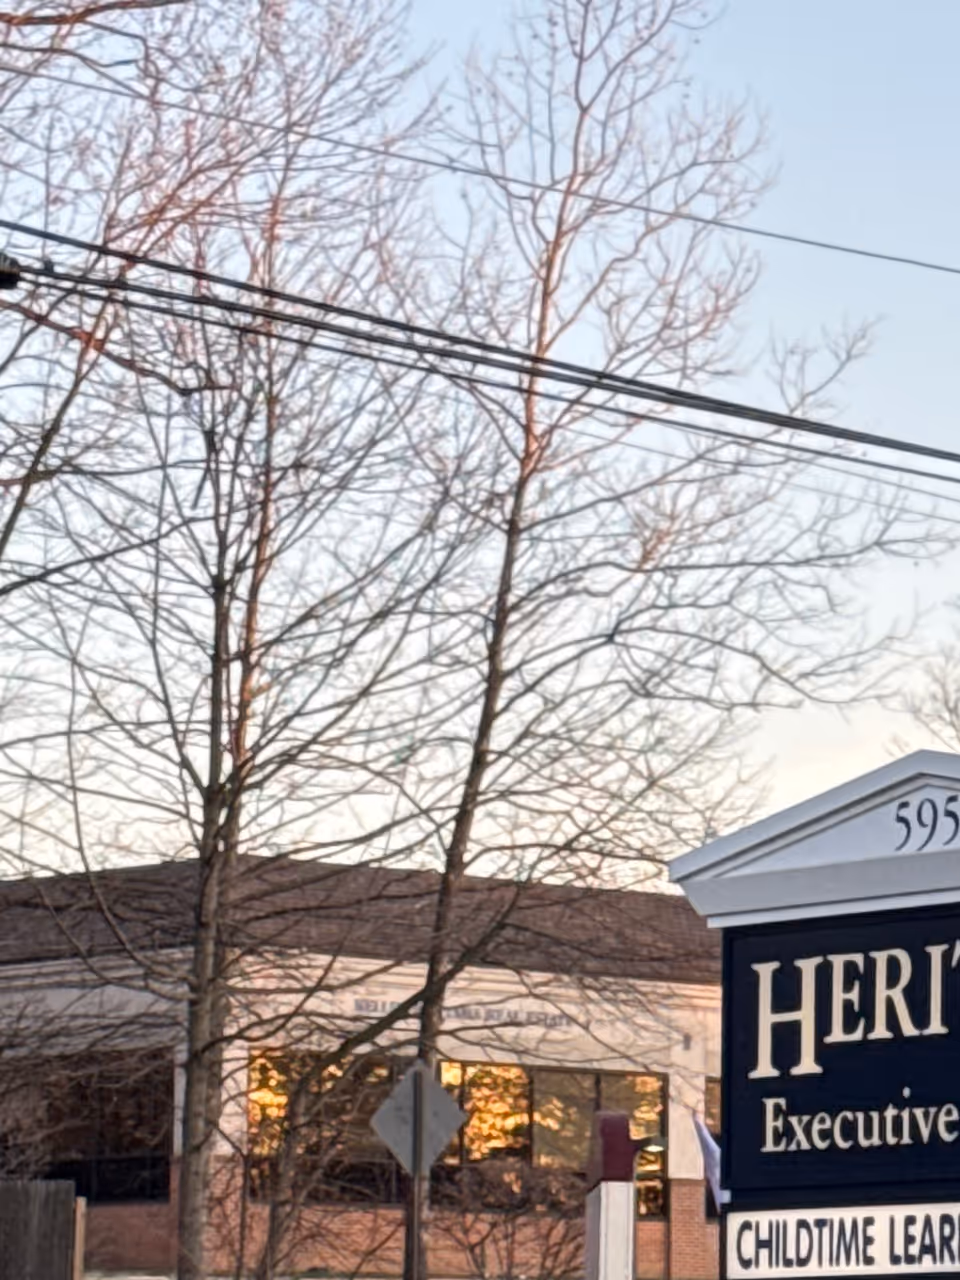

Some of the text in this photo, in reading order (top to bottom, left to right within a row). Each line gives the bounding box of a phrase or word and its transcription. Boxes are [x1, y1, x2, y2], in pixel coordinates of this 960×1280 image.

[894, 794, 960, 852] 595
[760, 1087, 960, 1153] Executive
[735, 1215, 876, 1270] CHILDTIME
